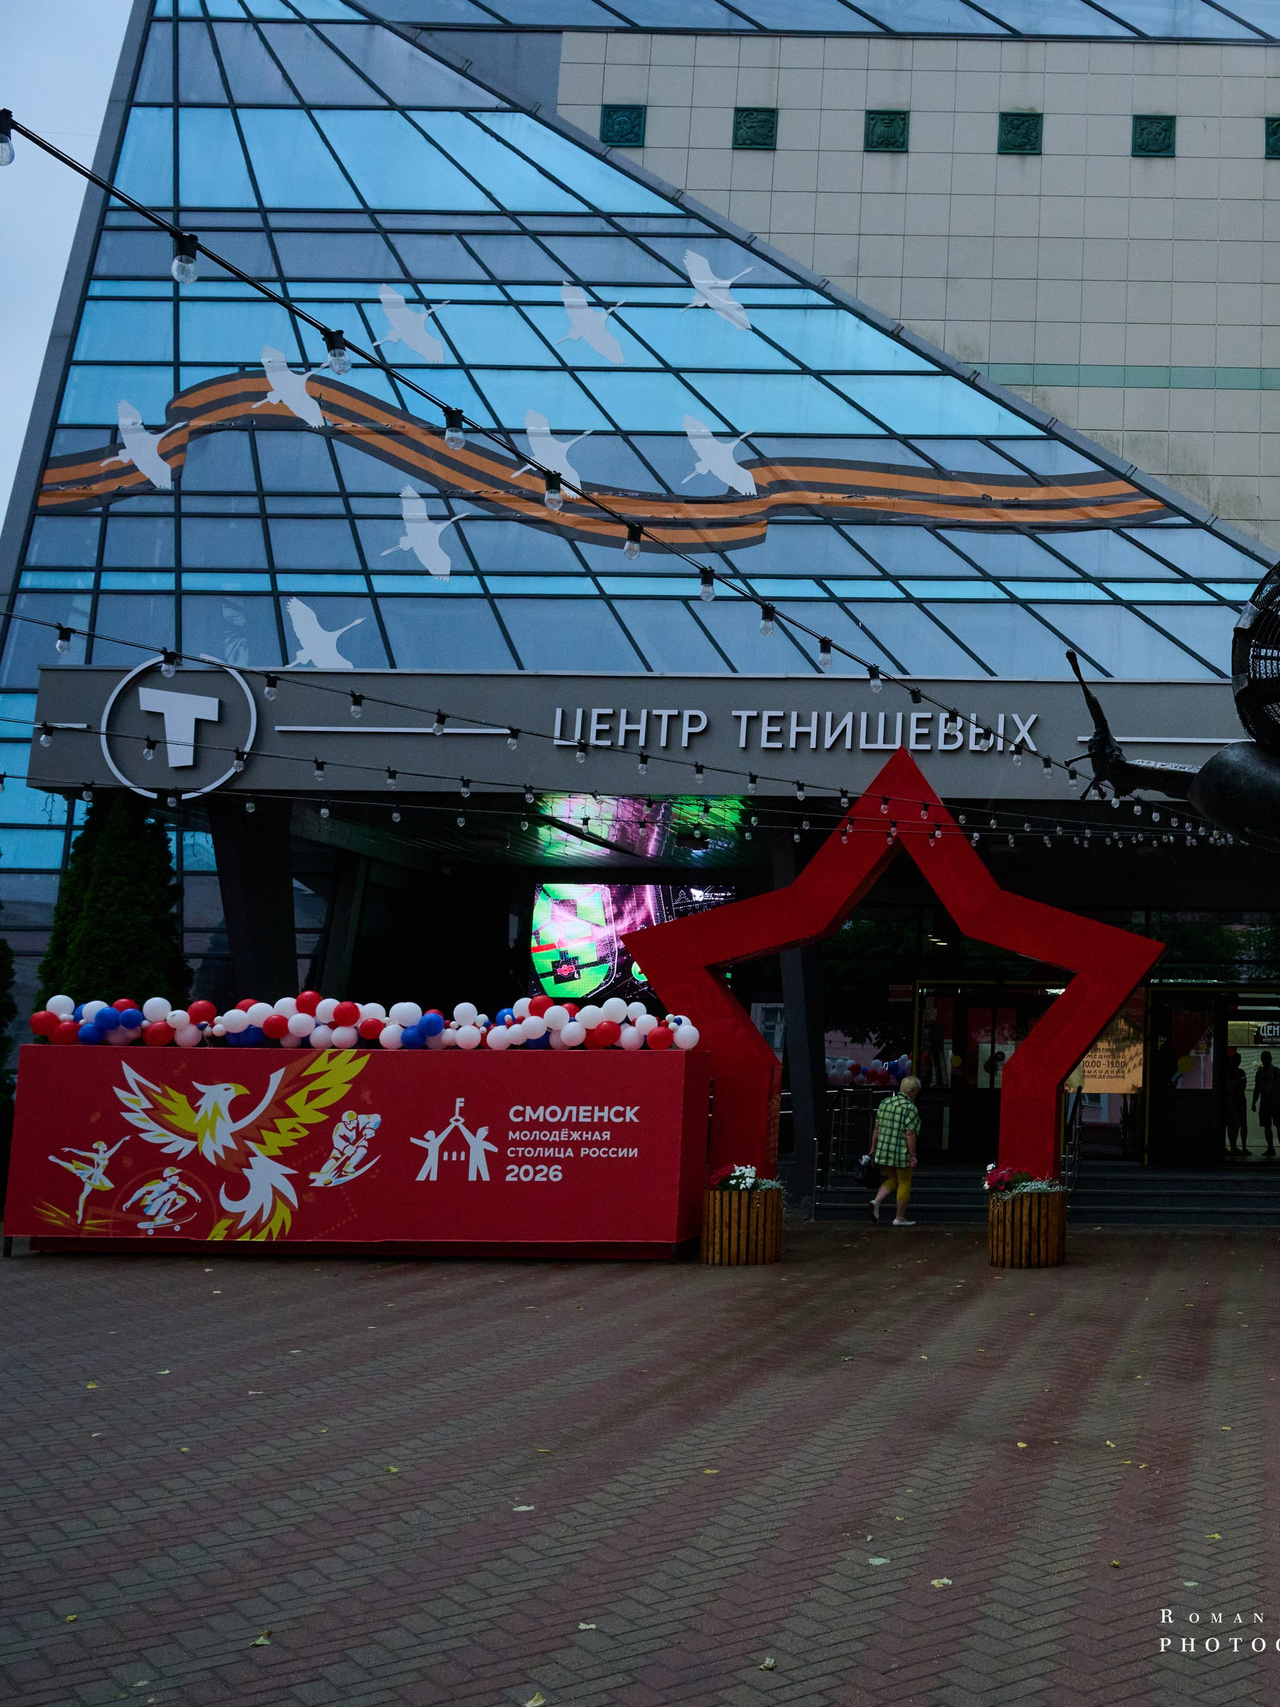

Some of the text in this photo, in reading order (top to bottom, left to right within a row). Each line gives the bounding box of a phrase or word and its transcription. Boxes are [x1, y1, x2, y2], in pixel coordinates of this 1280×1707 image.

[553, 707, 1039, 752] ЦЕНТР ТЕНИШЕВЫХ
[508, 1105, 641, 1123] СМОЛЕНСК
[508, 1128, 611, 1142] МОЛОДЁЖНАЯ
[506, 1147, 639, 1159] СТОЛИЦА РОССИИ
[504, 1164, 564, 1182] 2026
